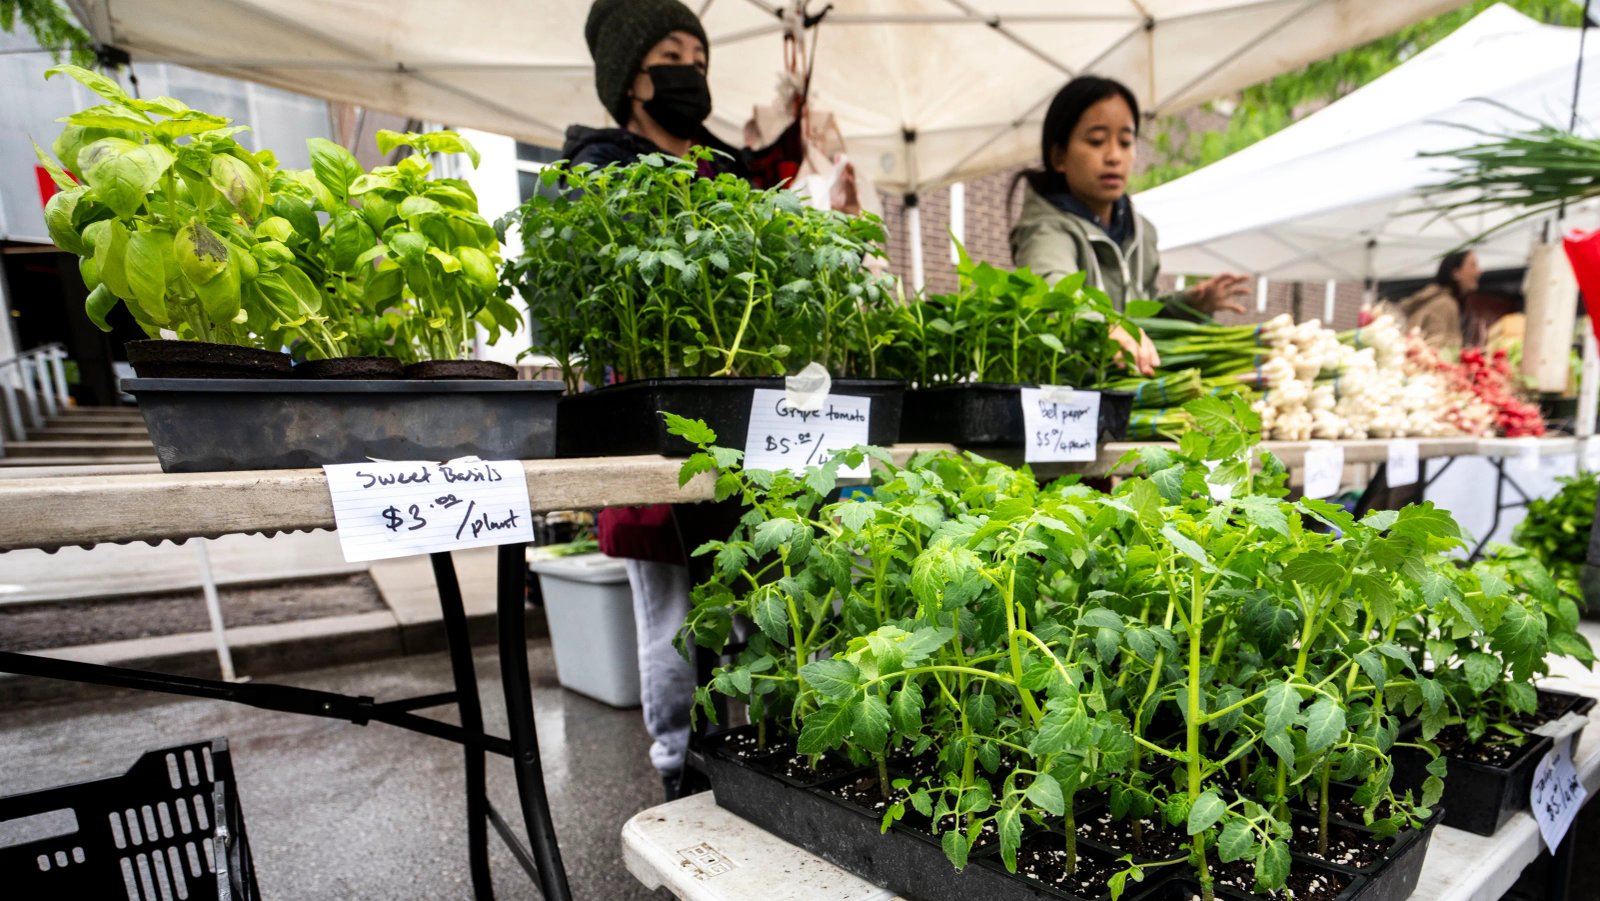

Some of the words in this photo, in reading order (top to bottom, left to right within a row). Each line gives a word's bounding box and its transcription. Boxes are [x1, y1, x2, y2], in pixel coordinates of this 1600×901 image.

[825, 404, 865, 422] tomato
[356, 466, 432, 488] Sweet
[439, 464, 502, 483] Basils
